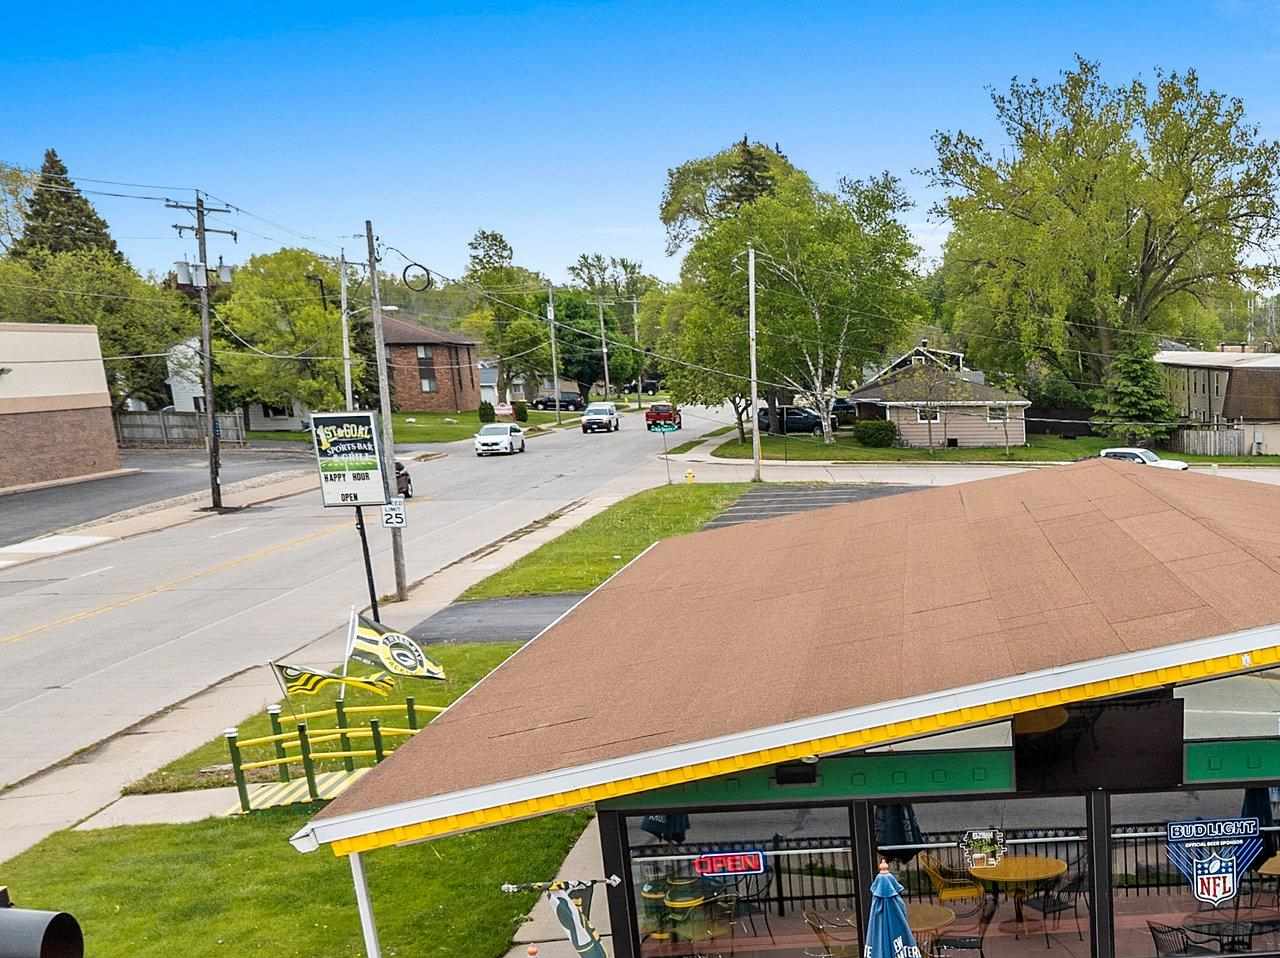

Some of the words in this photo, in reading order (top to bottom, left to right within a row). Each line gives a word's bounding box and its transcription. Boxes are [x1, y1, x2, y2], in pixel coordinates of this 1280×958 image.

[324, 473, 346, 482] HAPPY
[352, 472, 371, 481] HOUR
[341, 493, 358, 502] OPEN
[384, 513, 404, 524] 25
[1171, 823, 1207, 838] BUD
[1207, 820, 1256, 836] LIGHT
[692, 854, 760, 873] OPEN
[1199, 876, 1232, 898] NFL
